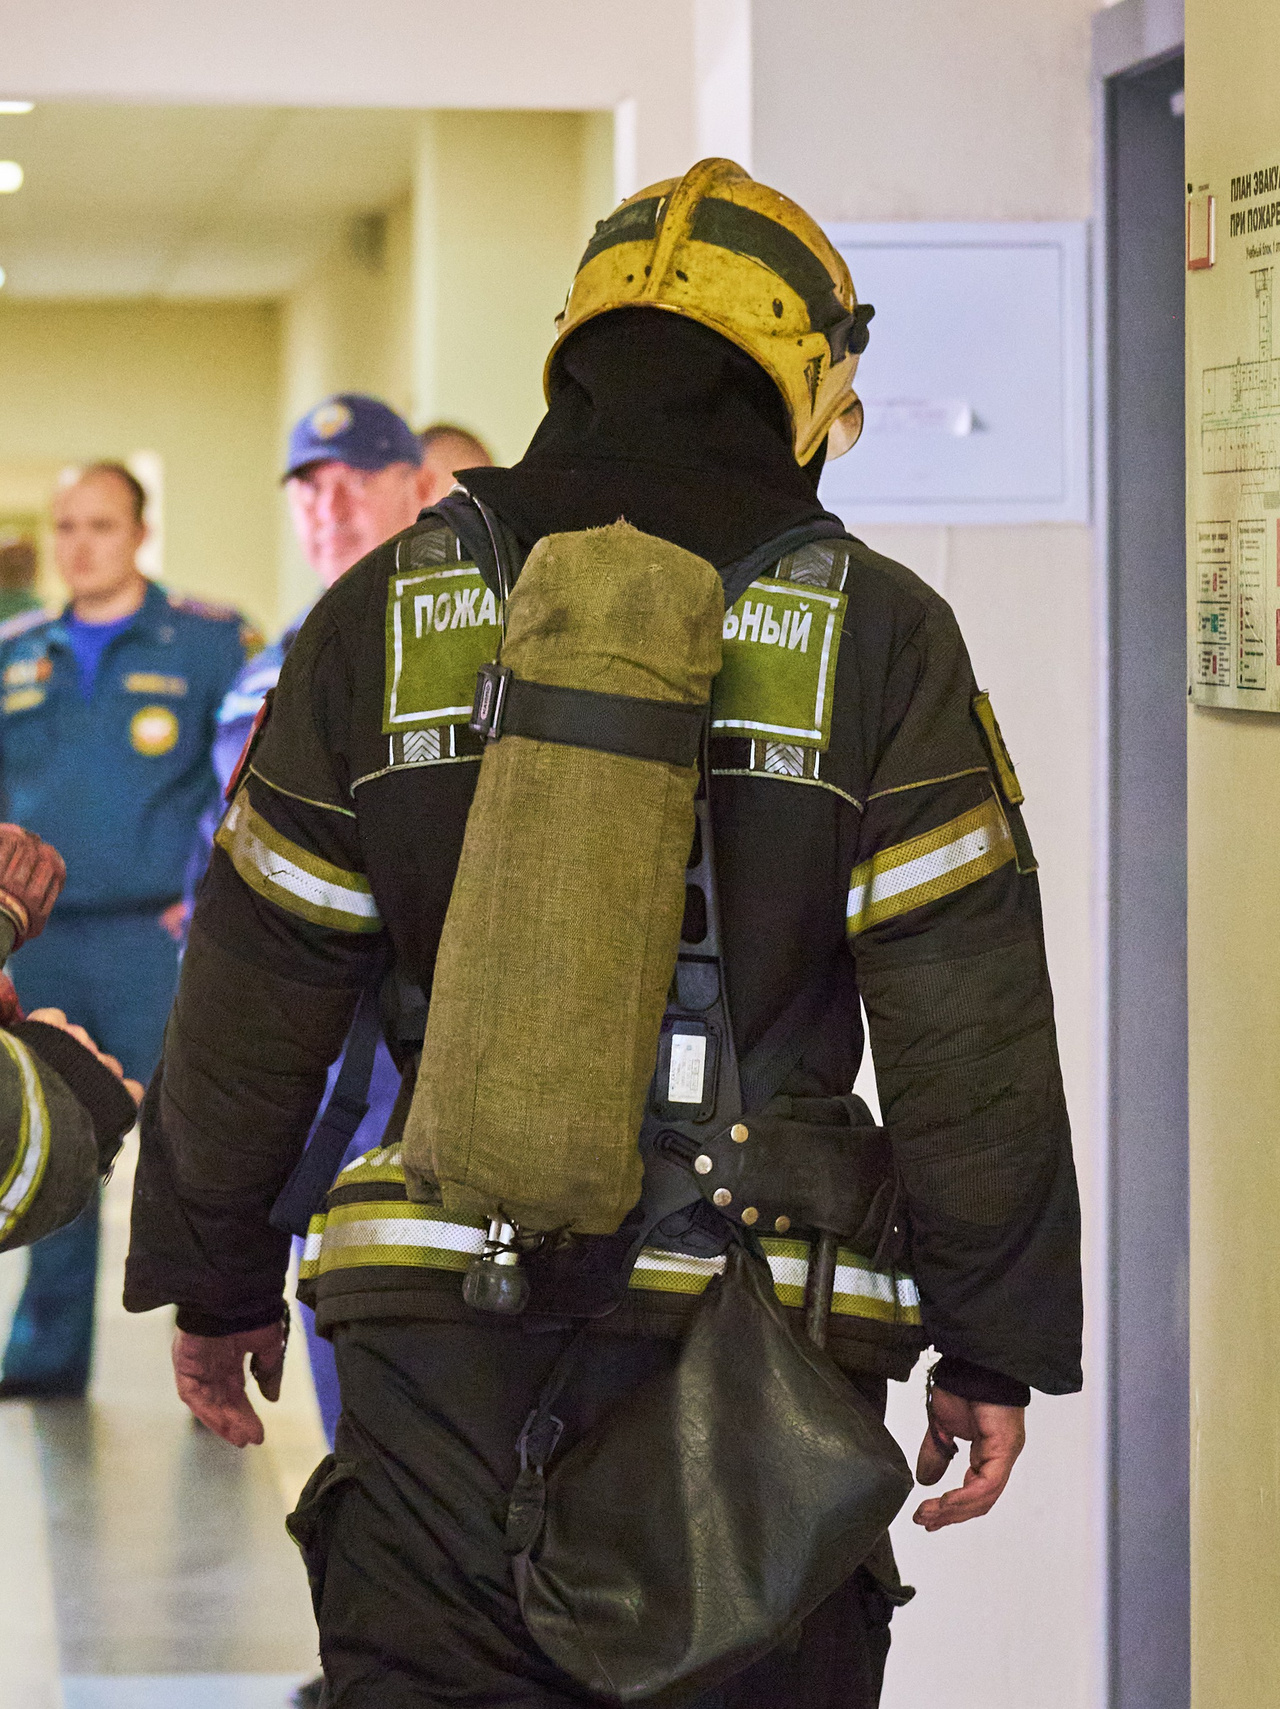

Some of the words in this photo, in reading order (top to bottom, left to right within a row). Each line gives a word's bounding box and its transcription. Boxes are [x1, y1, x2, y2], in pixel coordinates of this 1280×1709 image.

[1230, 173, 1252, 203] ПЛАН
[1253, 166, 1280, 196] ЭВАКУ
[1229, 211, 1246, 238] ПРИ
[1247, 201, 1280, 234] ПОЖАРЕ
[414, 587, 503, 639] ПОЖА
